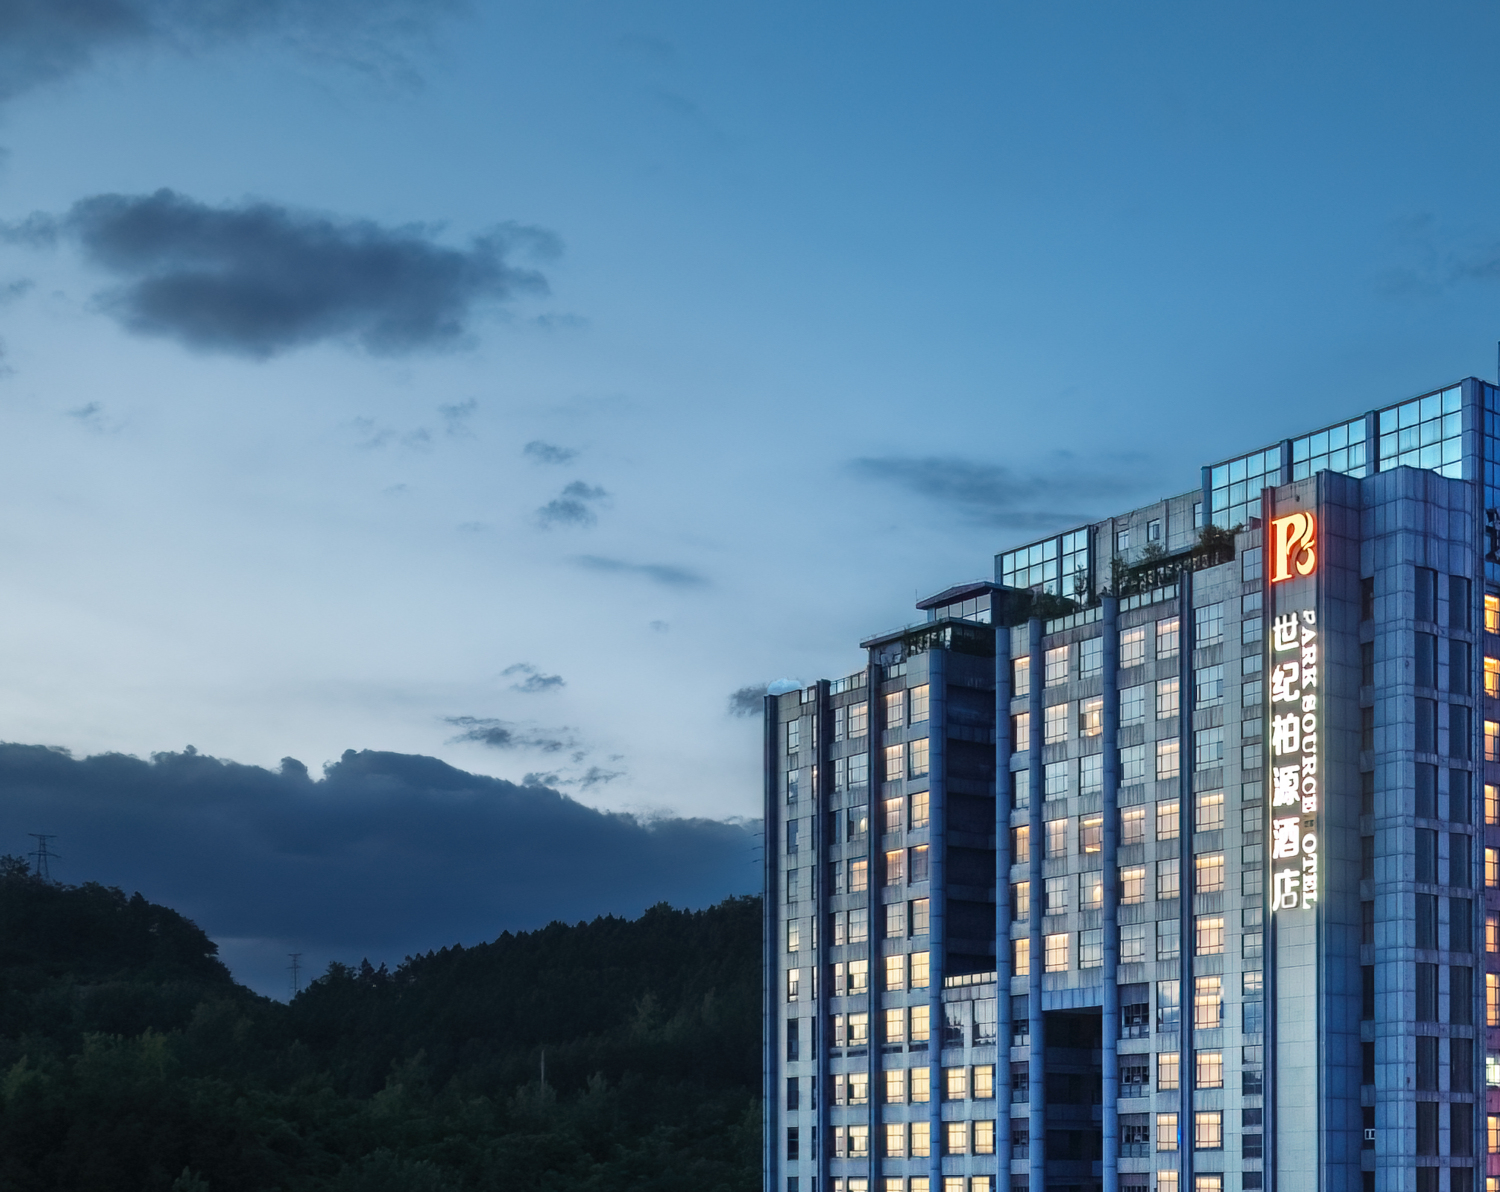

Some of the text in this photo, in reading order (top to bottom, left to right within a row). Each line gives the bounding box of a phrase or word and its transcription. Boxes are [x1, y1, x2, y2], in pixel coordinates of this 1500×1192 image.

[1301, 610, 1317, 689] PARK
[1272, 611, 1300, 911] 世纪柏源酒店
[1301, 694, 1317, 813] SOURCE
